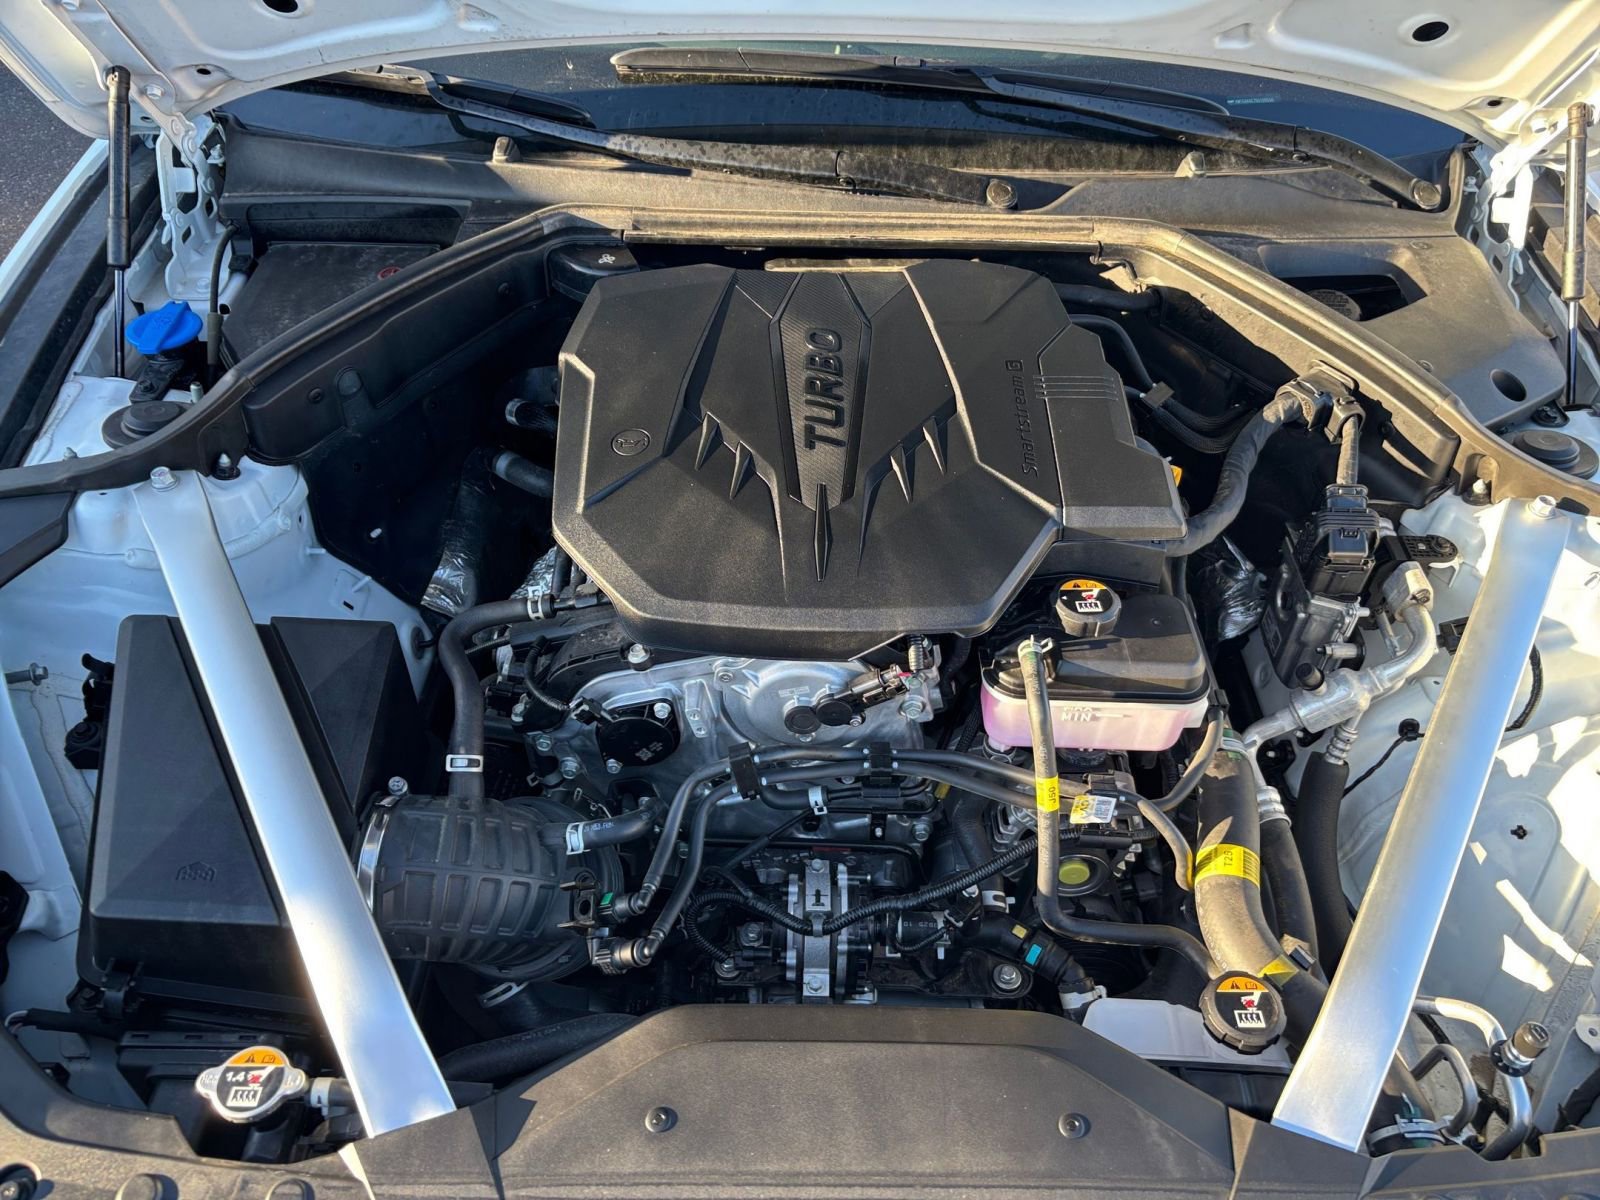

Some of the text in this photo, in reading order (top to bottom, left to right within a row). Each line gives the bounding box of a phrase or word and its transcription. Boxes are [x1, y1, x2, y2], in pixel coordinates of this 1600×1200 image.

[804, 327, 846, 450] TURBO
[1012, 374, 1038, 478] Smartstream
[1061, 711, 1093, 722] MIN
[1048, 786, 1057, 804] J50
[226, 1071, 246, 1083] 1.4
